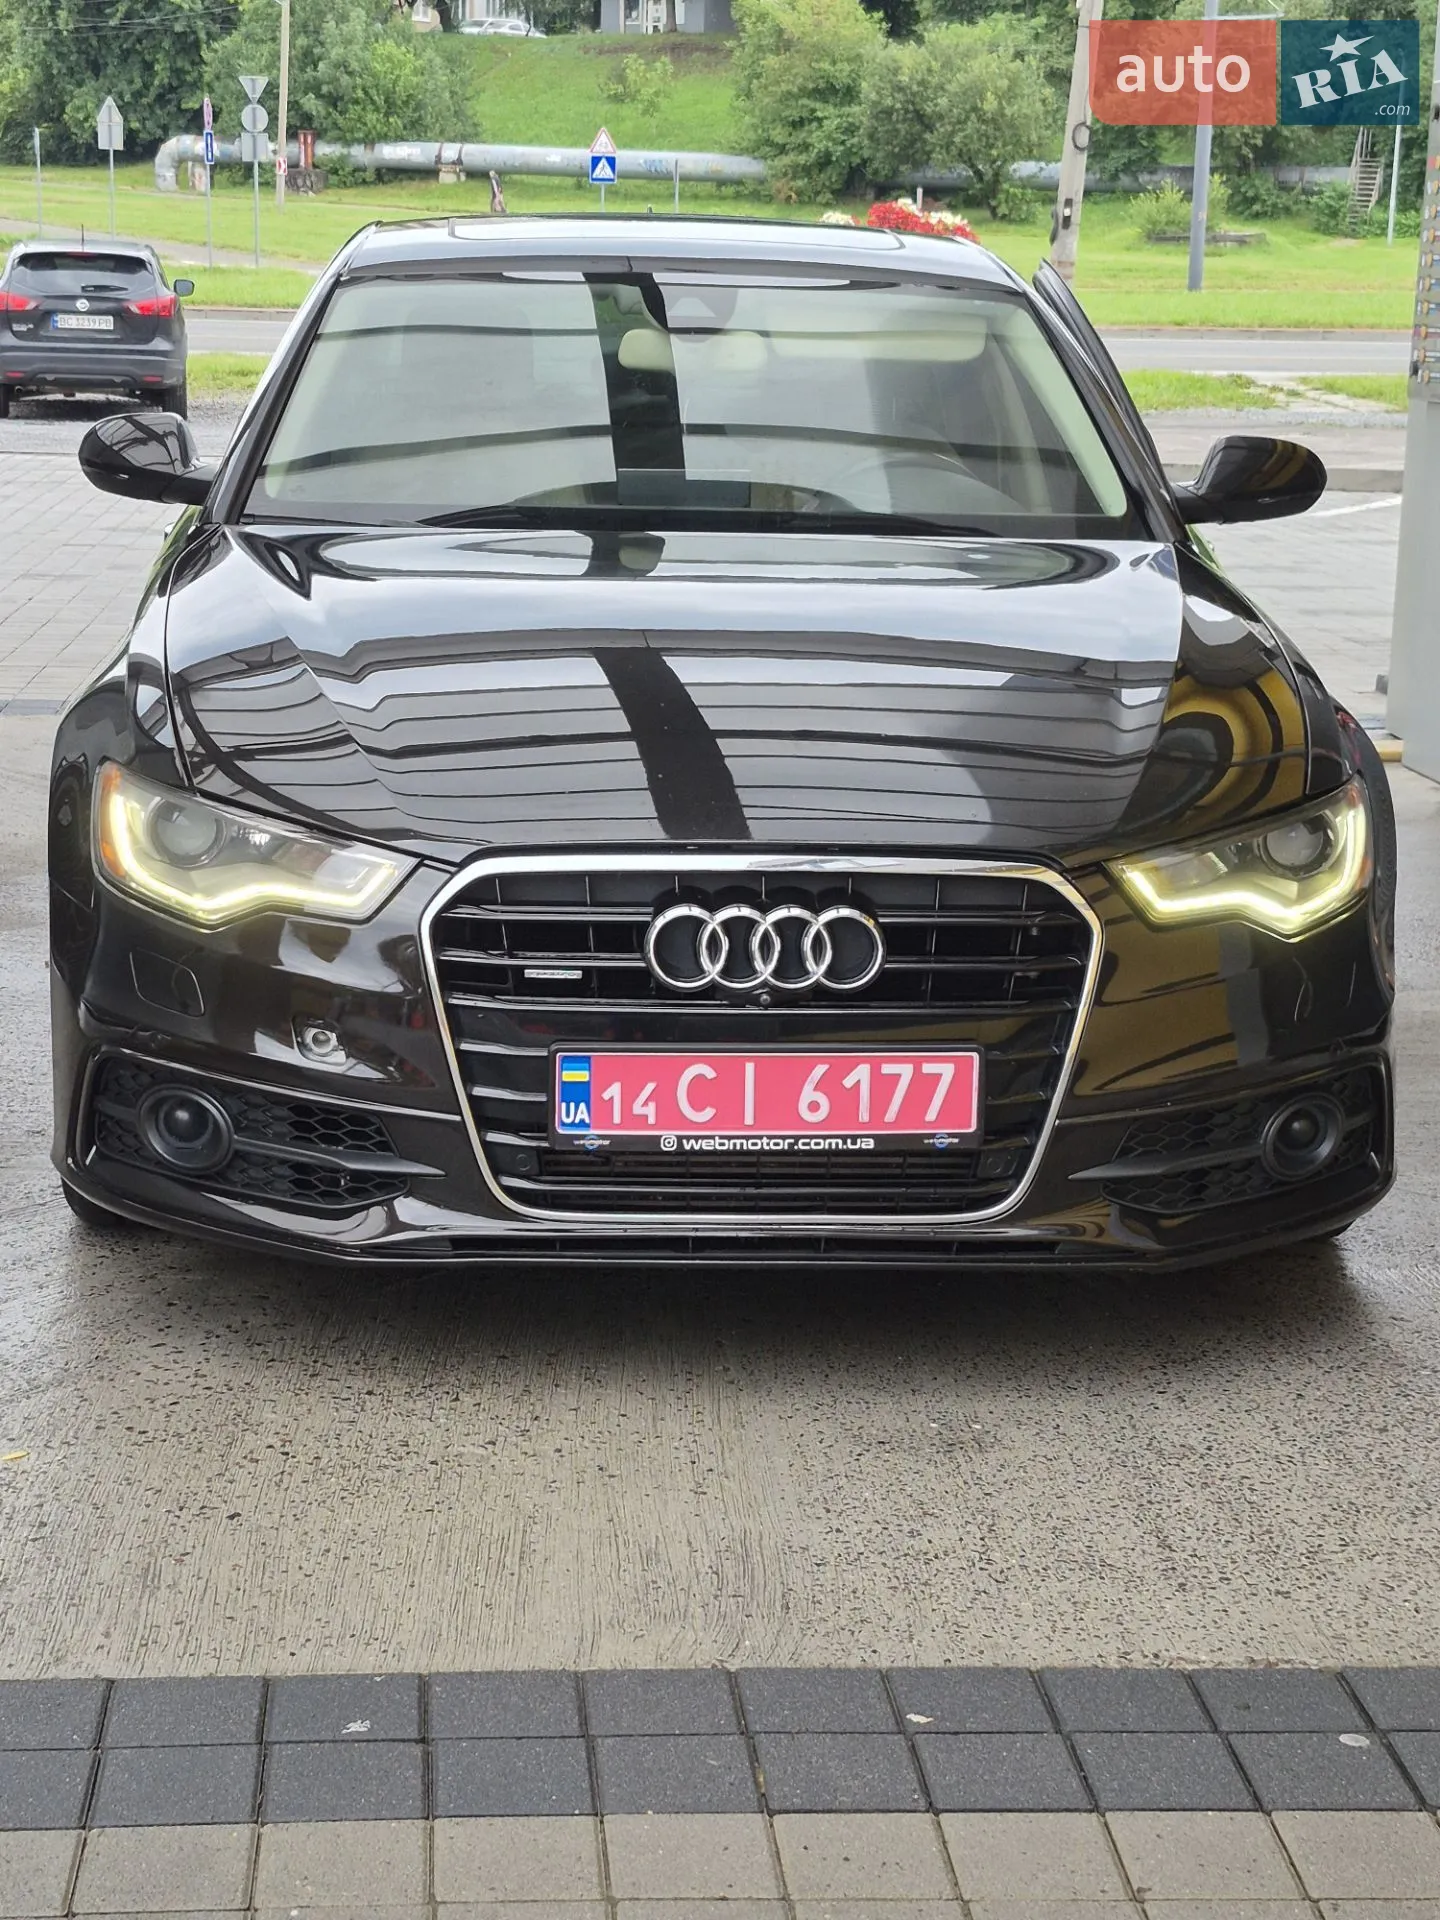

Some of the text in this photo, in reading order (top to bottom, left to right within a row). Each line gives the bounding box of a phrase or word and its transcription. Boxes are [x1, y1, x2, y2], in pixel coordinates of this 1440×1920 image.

[601, 1081, 657, 1125] 14
[797, 1062, 956, 1124] 6177
[561, 1102, 590, 1124] UA
[683, 1135, 875, 1151] webmotor.com.ua
